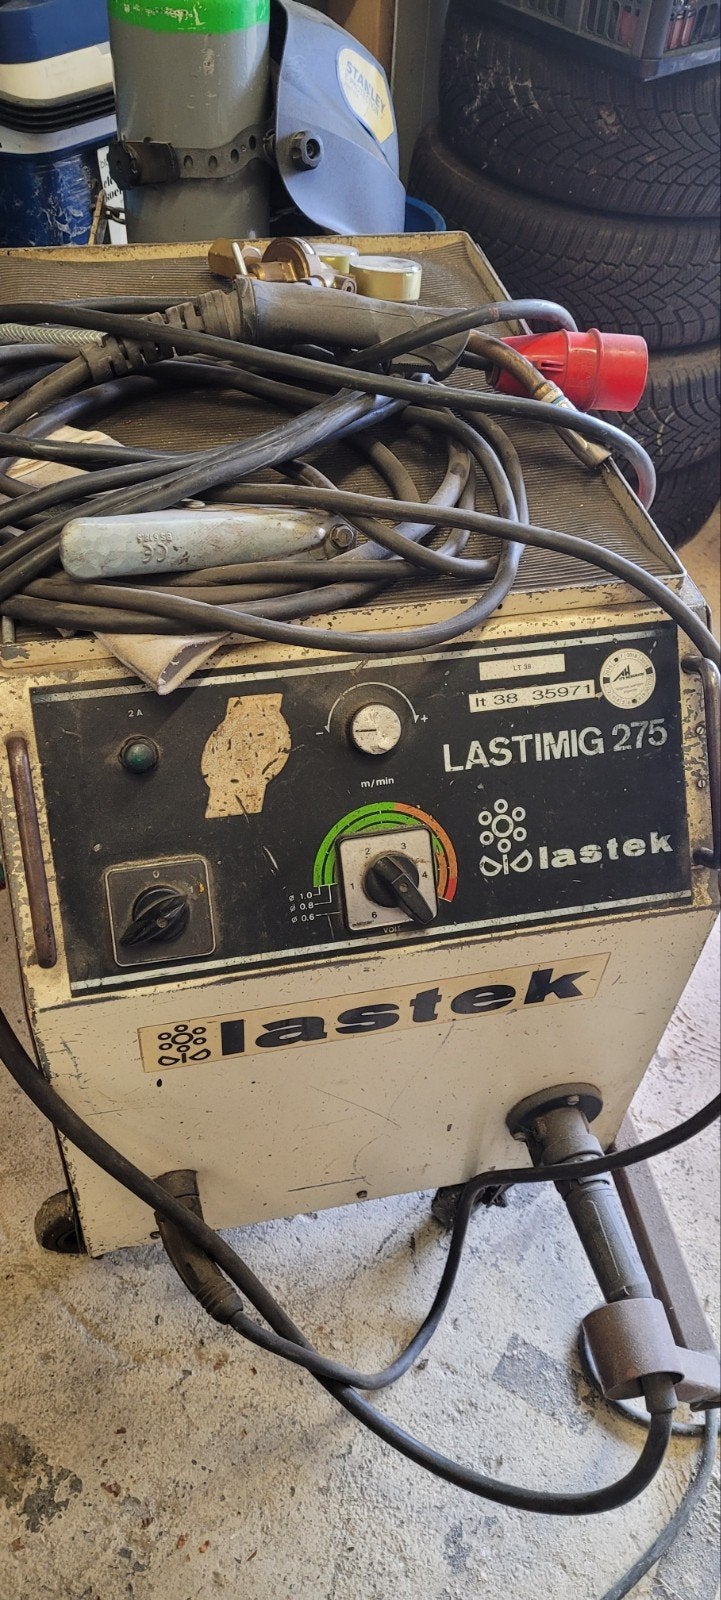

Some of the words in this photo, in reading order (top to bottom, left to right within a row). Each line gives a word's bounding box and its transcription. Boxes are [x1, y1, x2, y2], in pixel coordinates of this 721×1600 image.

[346, 61, 385, 113] STANLEY
[493, 693, 518, 705] 38
[532, 684, 591, 700] 35971
[127, 709, 135, 718] 2
[136, 708, 144, 717] A
[443, 726, 605, 772] LASTIMIG
[611, 718, 668, 752] 275
[361, 777, 395, 788] m/min
[364, 847, 371, 855] 2
[401, 842, 407, 850] 3
[539, 831, 673, 870] lastek
[350, 882, 355, 890] 1
[300, 891, 313, 900] 1.0
[300, 901, 314, 911] 0.8
[301, 913, 315, 922] 0.6
[371, 911, 378, 919] 6
[220, 968, 591, 1056] lastek
